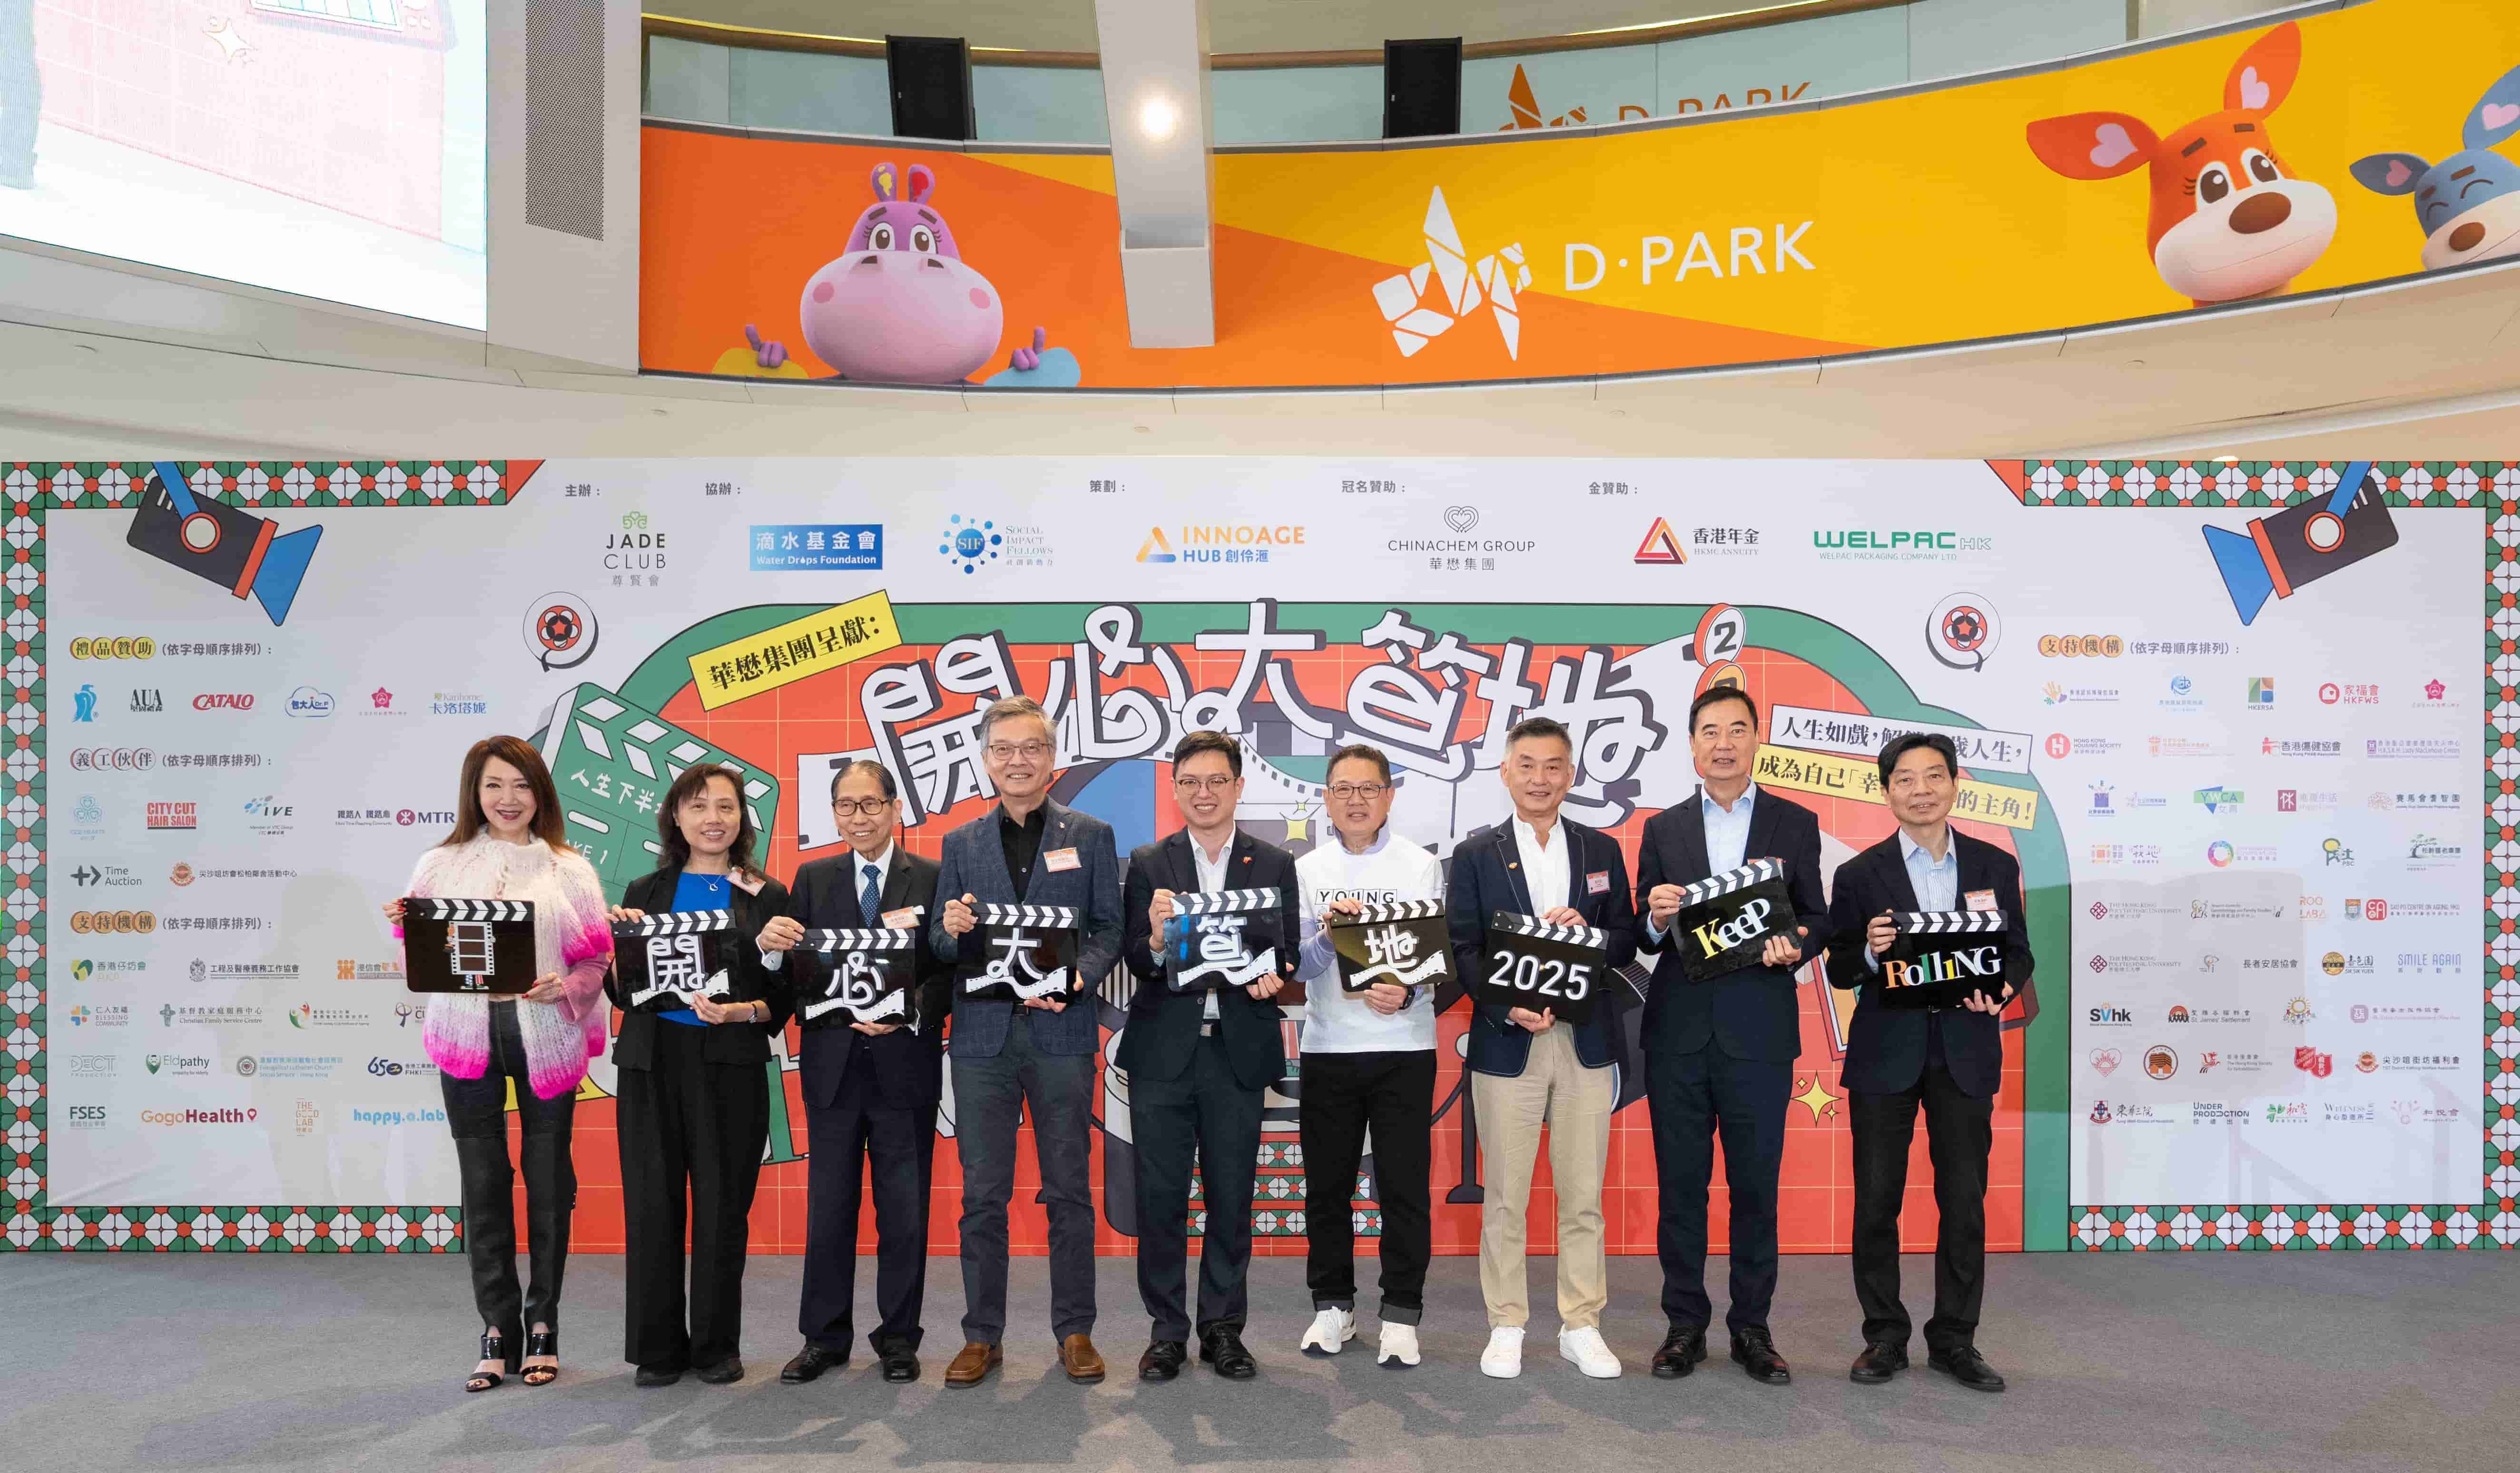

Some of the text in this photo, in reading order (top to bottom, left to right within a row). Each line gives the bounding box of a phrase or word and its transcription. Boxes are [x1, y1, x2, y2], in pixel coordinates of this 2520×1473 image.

[606, 533, 666, 549] JADE
[756, 531, 876, 551] 滴水基金會
[1183, 526, 1305, 545] INNOAGE
[1693, 528, 1760, 545] 香港年金
[1814, 531, 1956, 549] WELPAC
[958, 538, 982, 550] SIF
[1388, 540, 1536, 552] CHINACHEM GROUP
[603, 553, 666, 570] CLUB
[757, 555, 876, 566] Water Drops Foundation
[1183, 550, 1221, 563] HUB
[1854, 552, 1899, 560] PACKAGING
[1429, 558, 1495, 571] 華懋集團
[612, 574, 659, 586] 尊賢會
[2045, 637, 2120, 655] 支持機構
[130, 689, 162, 705] AUA
[2344, 685, 2379, 696] 家福會
[193, 694, 254, 710] CATALO
[292, 700, 315, 709] 包大人
[430, 702, 486, 714] 卡洛塔妮
[2201, 792, 2238, 803] YWCA
[147, 803, 197, 815] CITY CUT
[264, 806, 293, 816] IVE
[147, 816, 197, 826] HAIR SALON
[418, 812, 455, 824] MTR
[105, 866, 128, 875] Time
[105, 877, 142, 886] Auction
[75, 913, 154, 932] 支持機構
[1364, 924, 1419, 969] 地
[986, 927, 1047, 980] 大
[2398, 954, 2461, 965] SMILE AGAIN
[646, 934, 708, 991] 開
[2243, 960, 2298, 968] 長者安居協會
[824, 952, 885, 1005] 心
[1488, 951, 1592, 1000] 2025
[2090, 1009, 2131, 1021] SVhk
[164, 1055, 209, 1069] Eldpathy
[2383, 1056, 2460, 1064] 尖沙咀街坊福利會
[70, 1106, 106, 1119] FSES
[141, 1109, 243, 1126] GogoHealth
